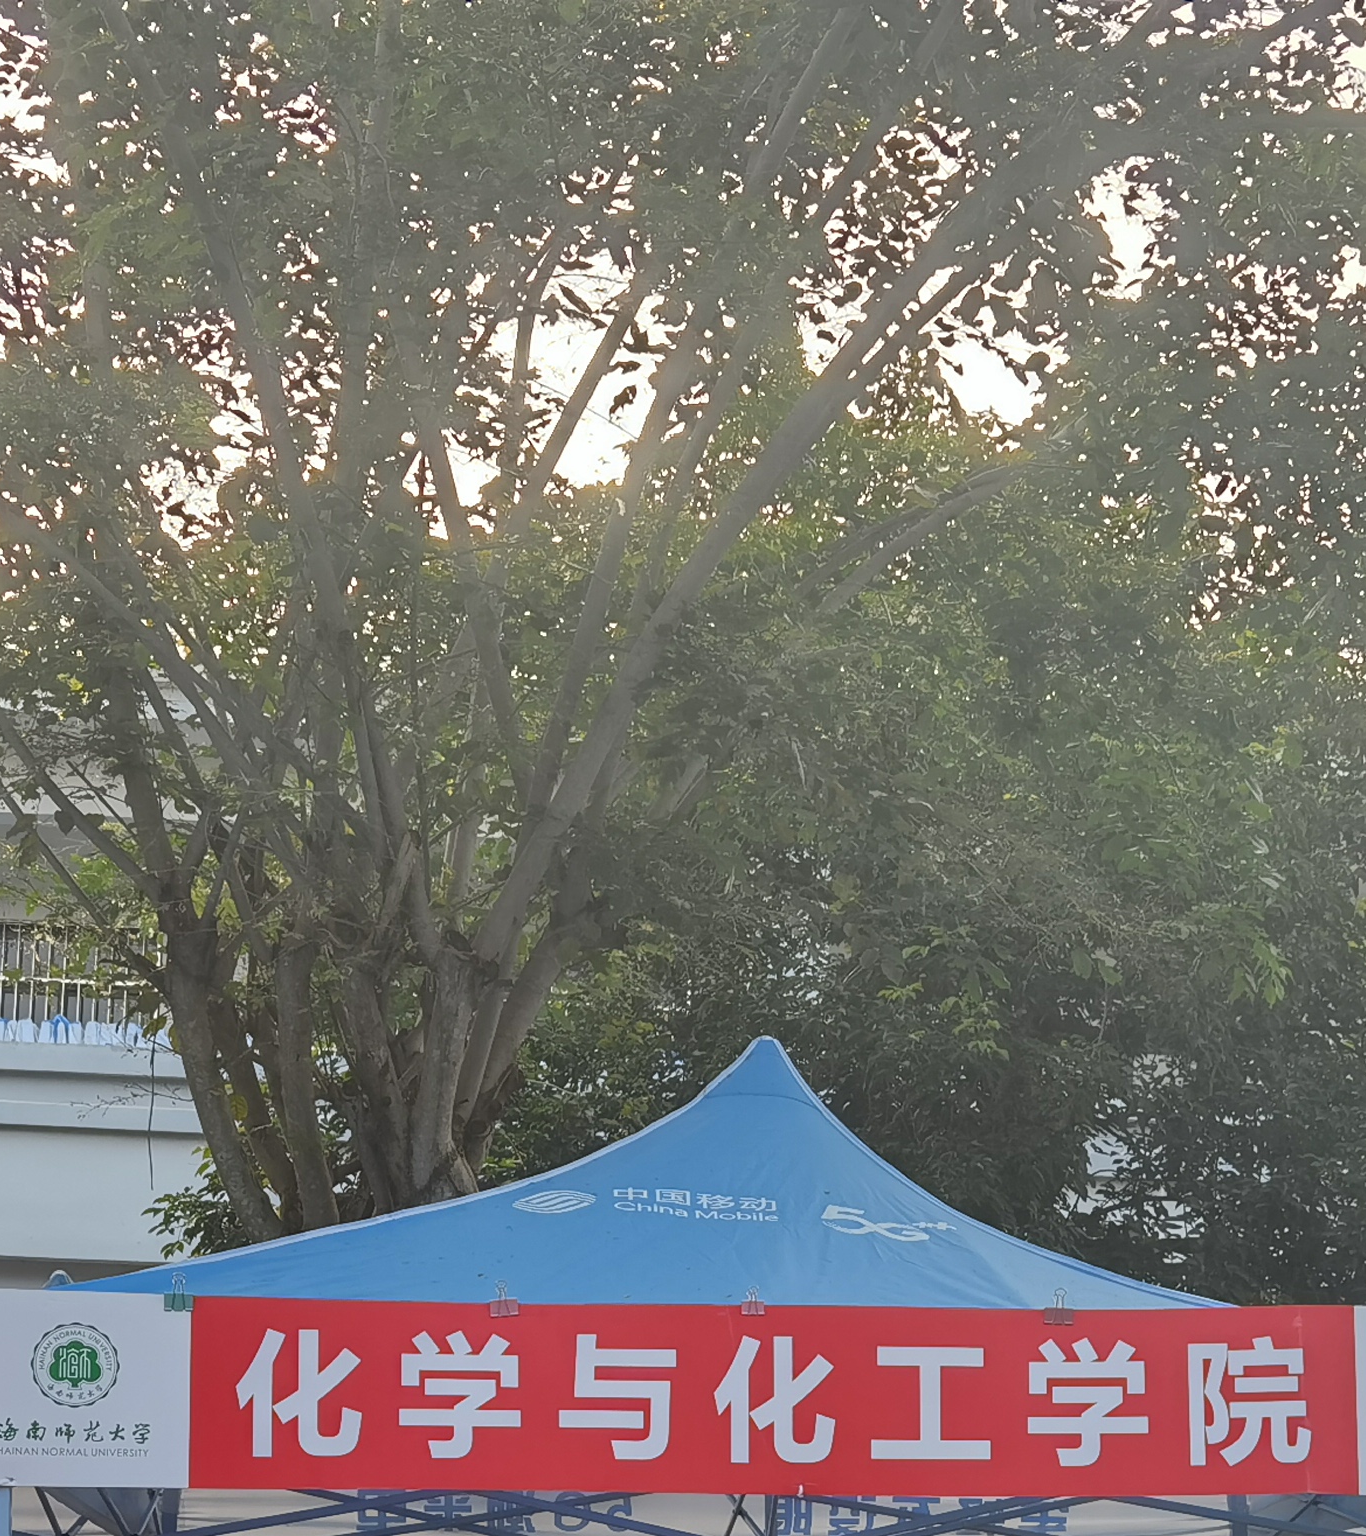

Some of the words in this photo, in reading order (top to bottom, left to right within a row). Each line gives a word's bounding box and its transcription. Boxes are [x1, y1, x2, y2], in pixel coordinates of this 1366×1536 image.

[611, 1186, 778, 1213] 中国移动
[613, 1200, 690, 1219] China
[693, 1208, 780, 1223] Mobile
[235, 1328, 1312, 1467] 化学与化工学院
[41, 1447, 89, 1457] NORMAL
[91, 1448, 149, 1458] UNIVERSITY
